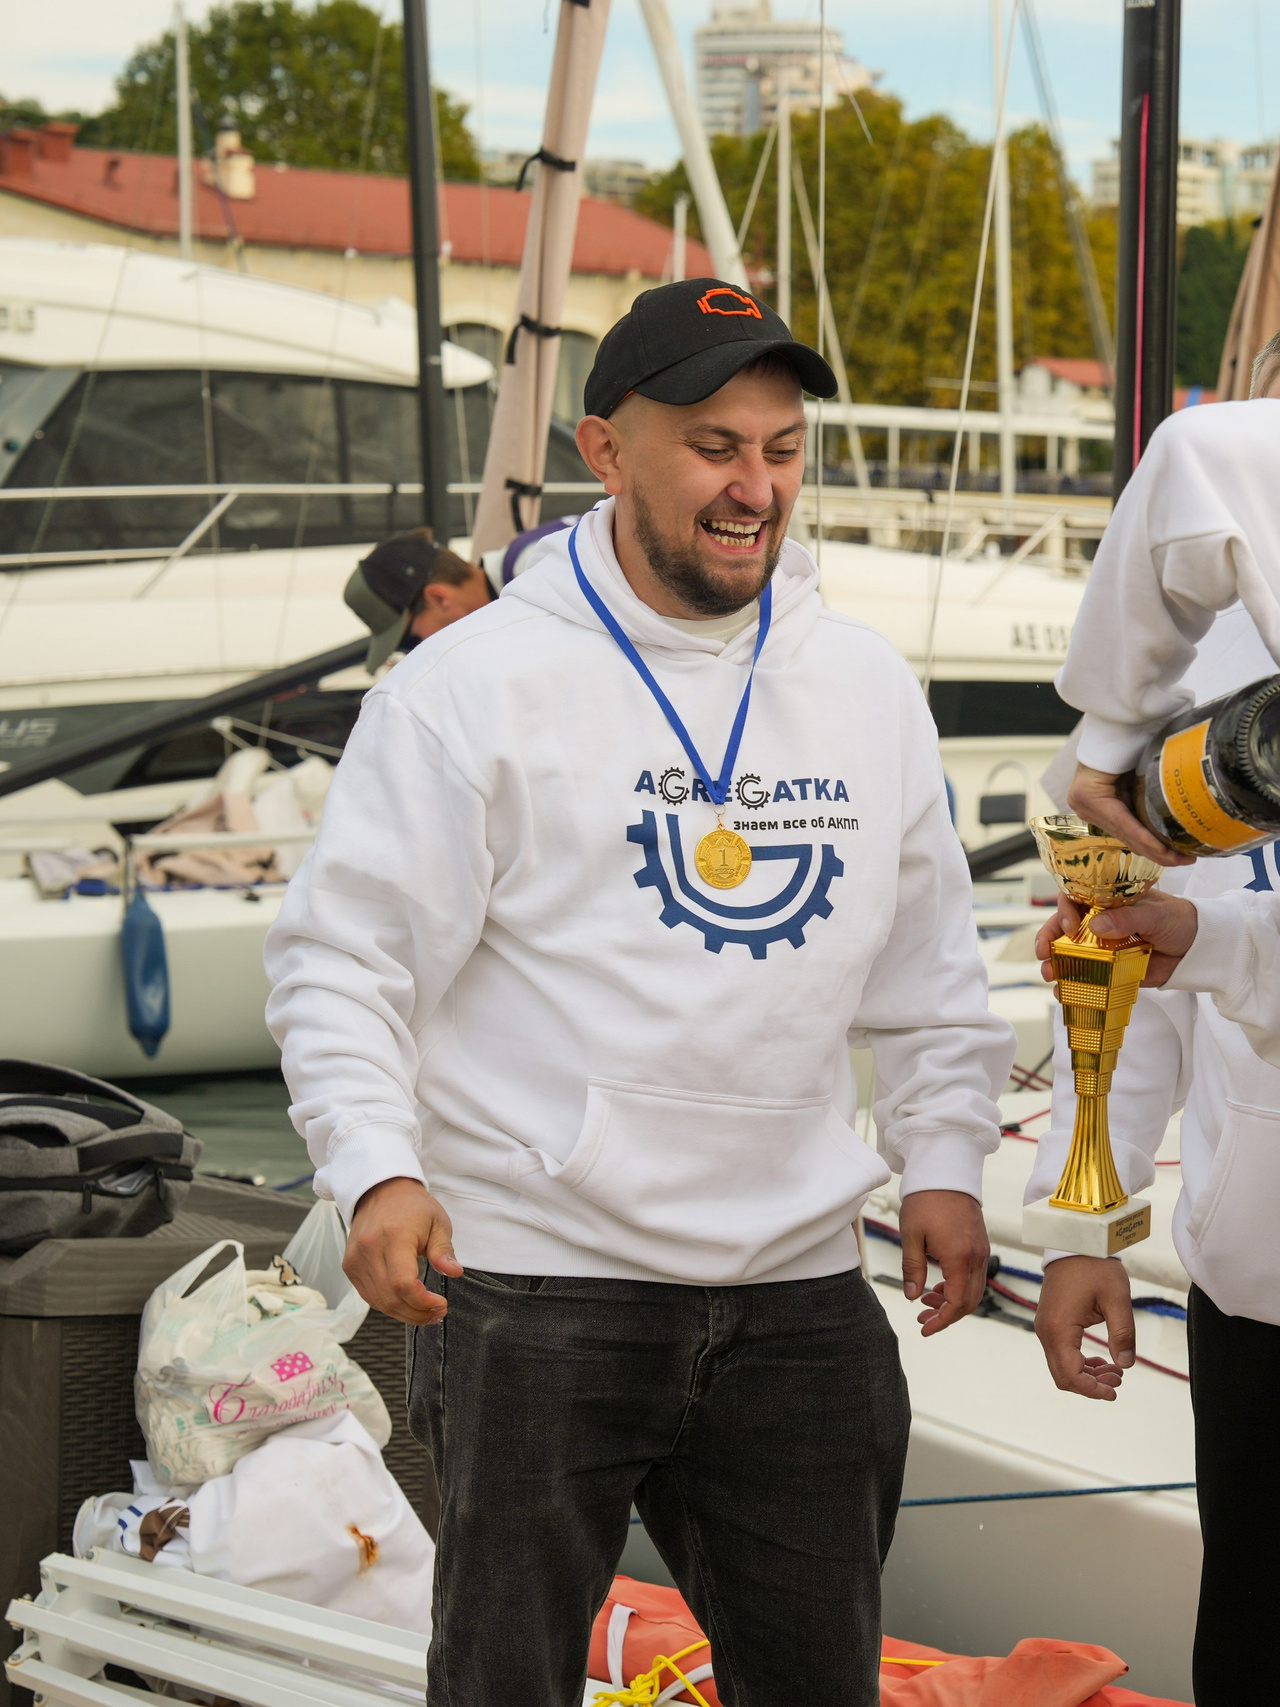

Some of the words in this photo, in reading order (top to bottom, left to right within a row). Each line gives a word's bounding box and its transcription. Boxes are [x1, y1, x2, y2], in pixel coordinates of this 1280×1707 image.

[1173, 768, 1212, 831] PROSECCO
[733, 820, 779, 831] знаем
[783, 818, 807, 830] все
[810, 816, 825, 829] об
[828, 816, 859, 830] АКПП
